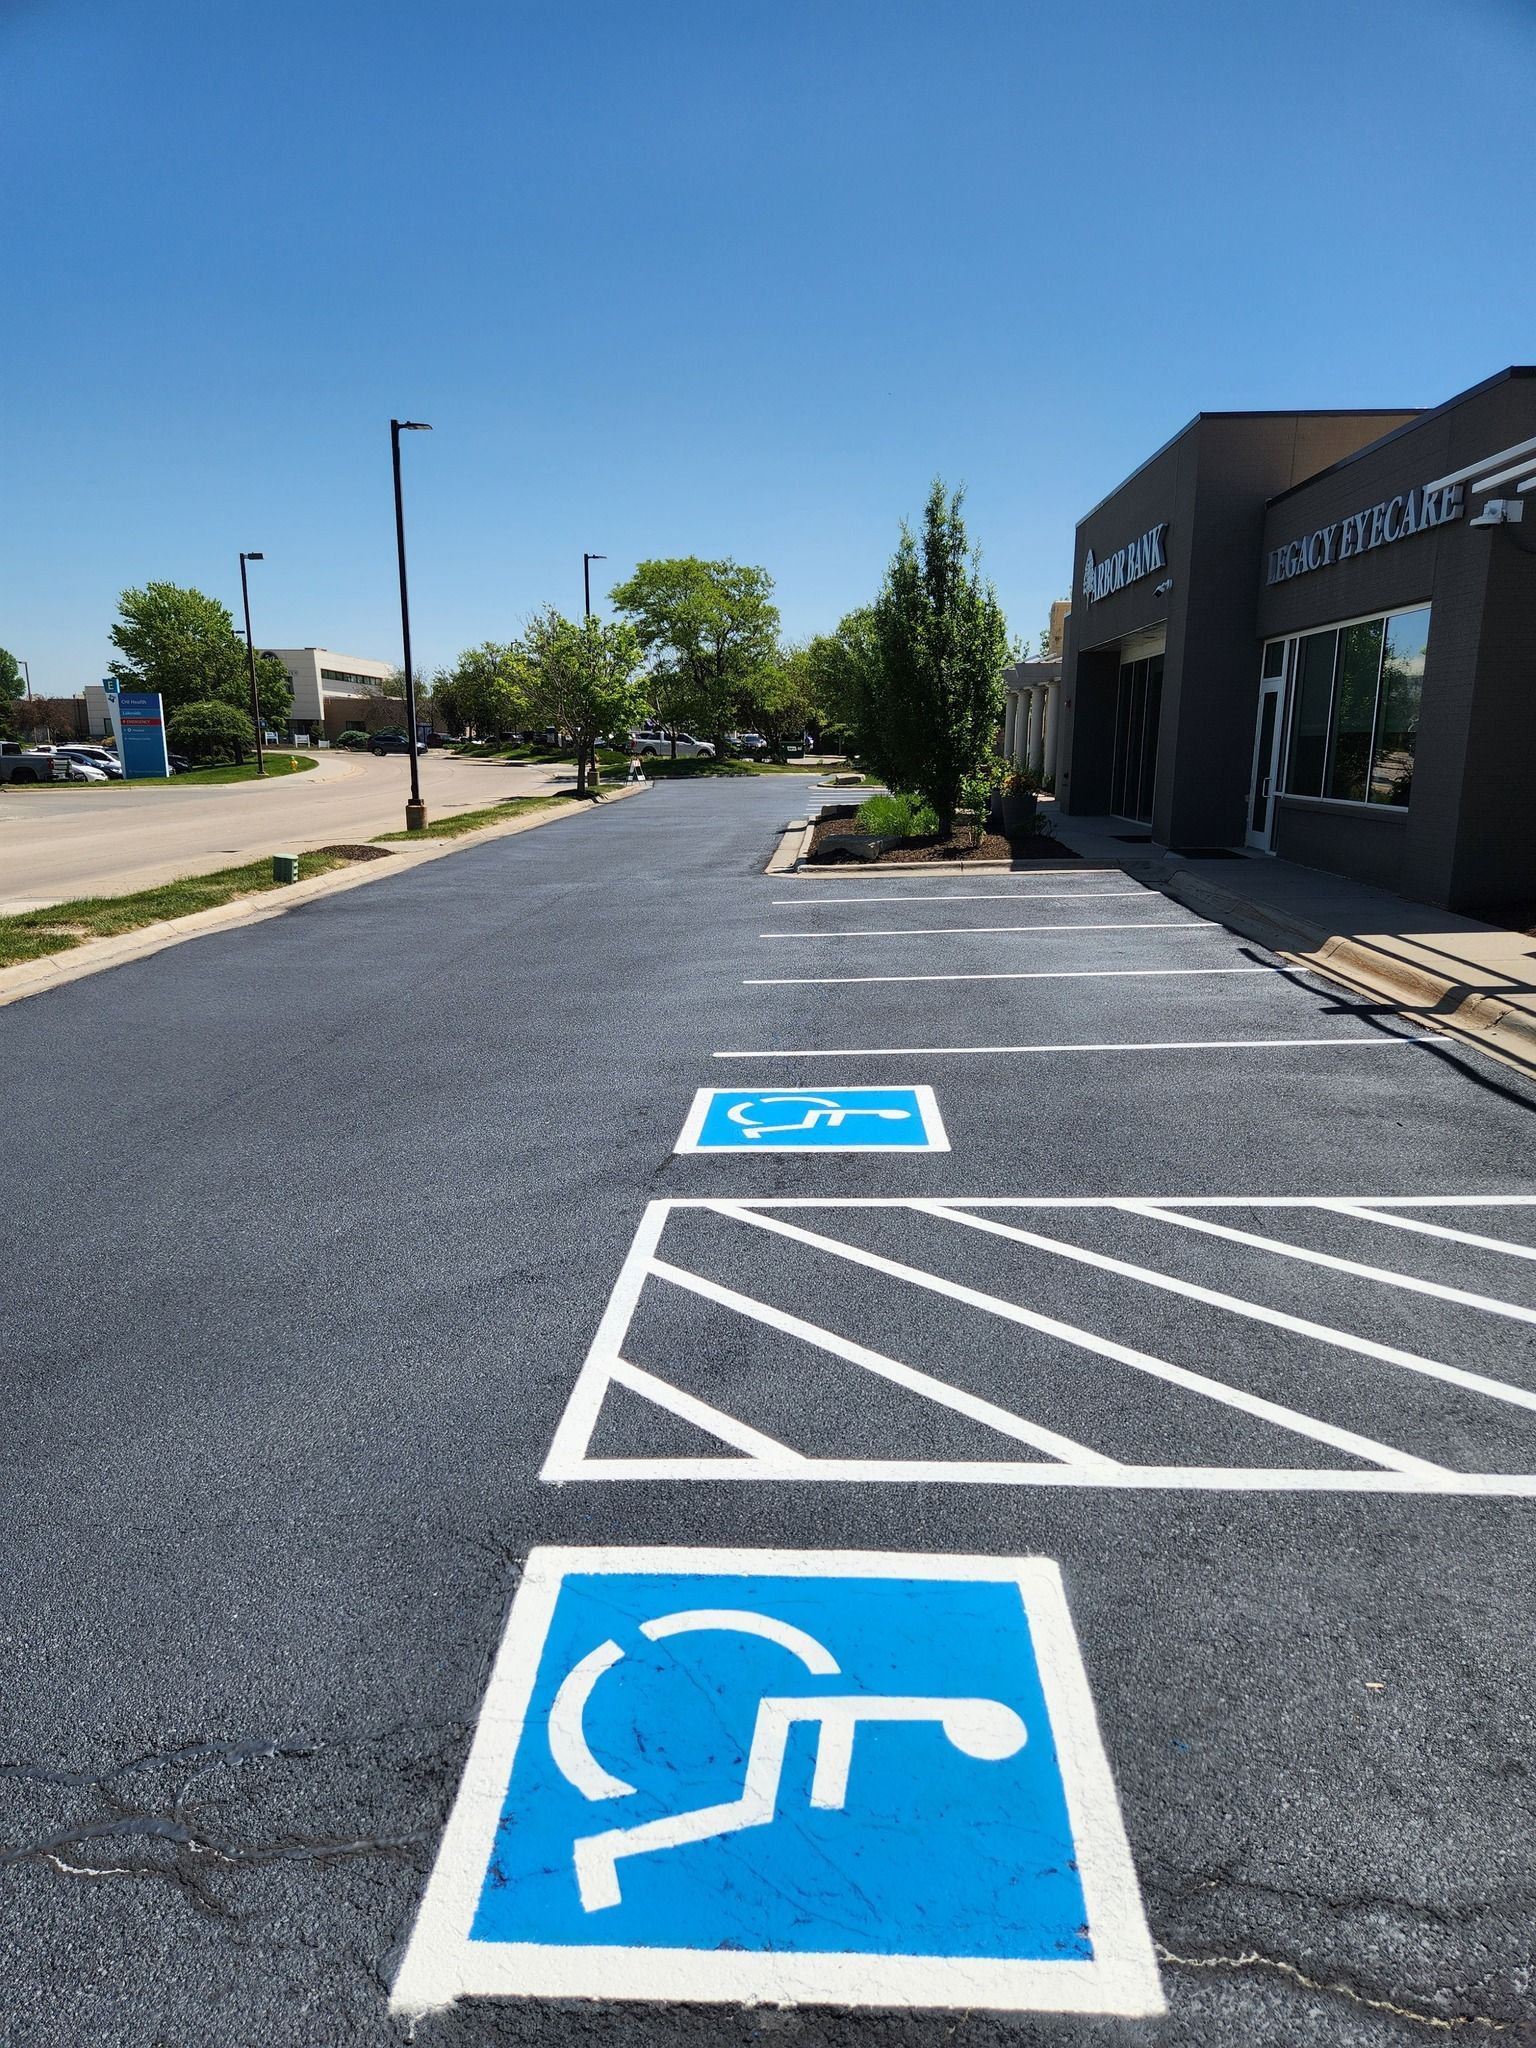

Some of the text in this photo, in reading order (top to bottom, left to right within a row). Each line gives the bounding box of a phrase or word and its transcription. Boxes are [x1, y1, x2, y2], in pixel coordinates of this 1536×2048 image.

[1090, 523, 1165, 604] ARBOR BANK
[1266, 485, 1461, 586] LEGACY EYECARE
[107, 681, 114, 690] E
